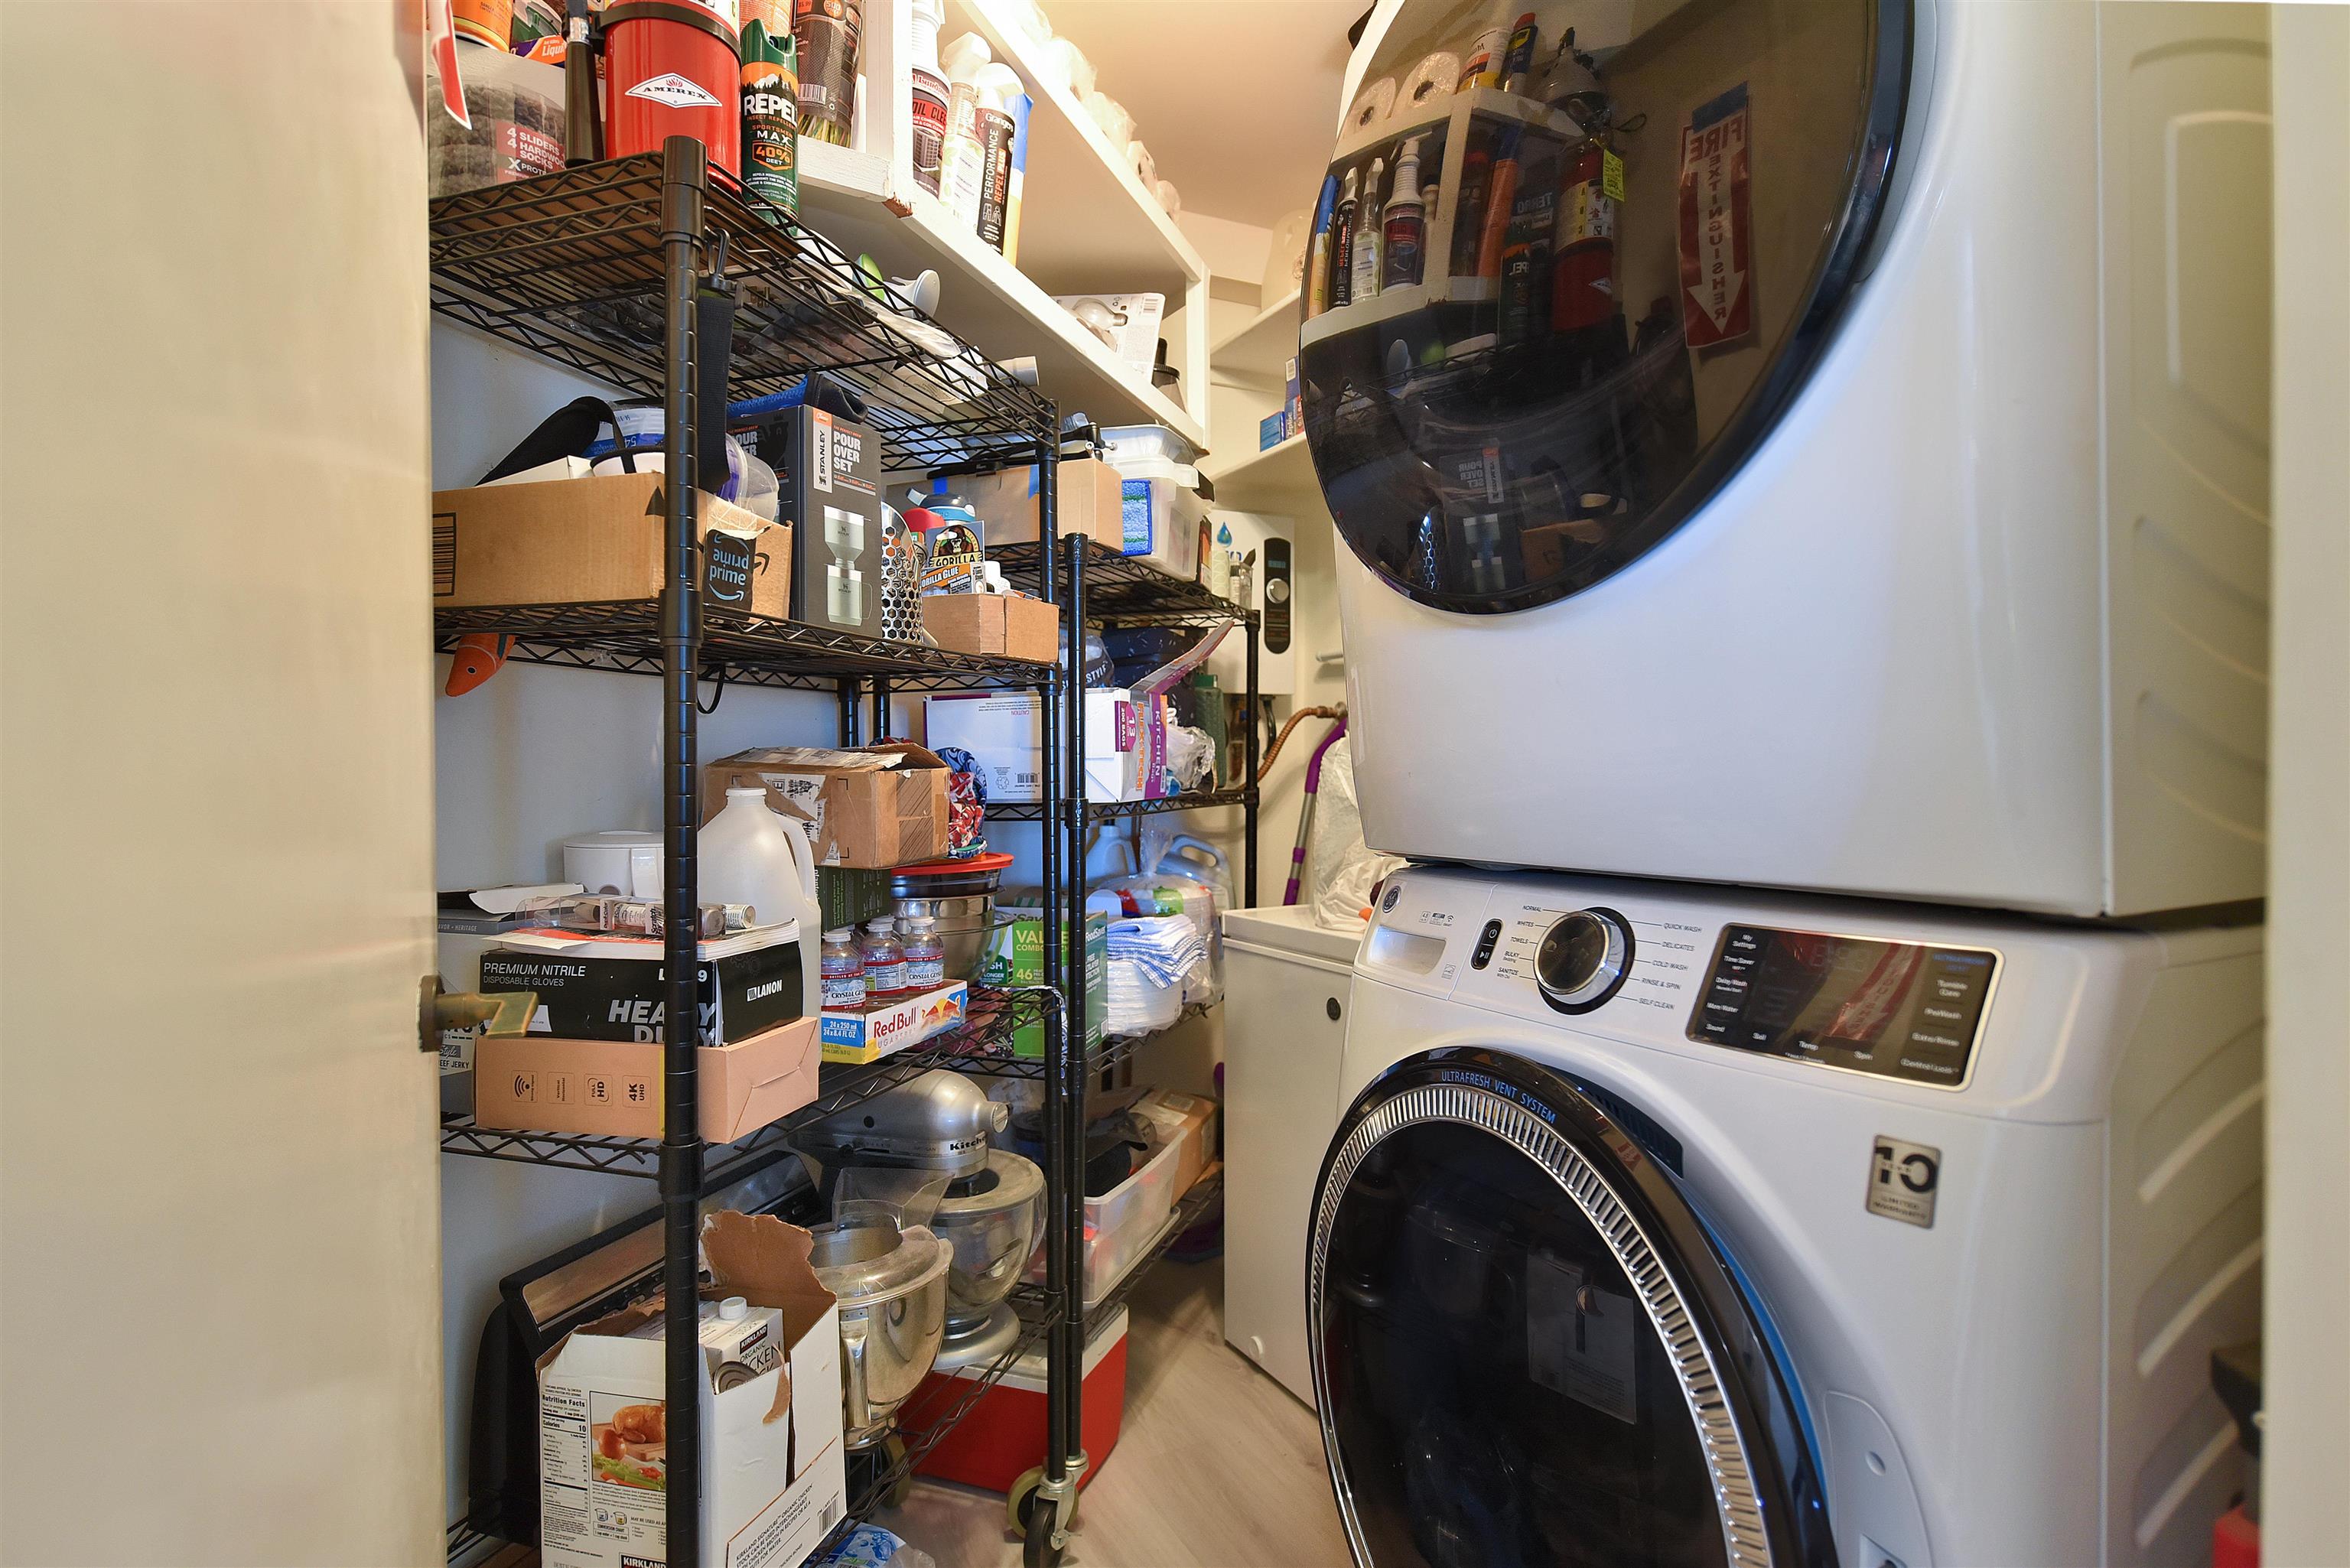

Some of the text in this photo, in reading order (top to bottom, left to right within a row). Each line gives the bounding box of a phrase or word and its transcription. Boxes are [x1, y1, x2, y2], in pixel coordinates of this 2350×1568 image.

[642, 86, 708, 100] AMEREX
[744, 93, 797, 127] REPEL
[913, 101, 926, 115] OIL
[752, 124, 793, 139] SPORTSMEN
[757, 130, 794, 149] MAX
[507, 128, 559, 156] 4 SLIDERS
[507, 138, 566, 170] 4 HARDWOO
[520, 151, 553, 169] SOCKS
[757, 146, 790, 163] 40%
[997, 150, 1007, 173] PLUS
[508, 157, 547, 176] X PROTE
[984, 129, 999, 200] PERFORMANCE
[994, 174, 1004, 203] REPEL
[732, 431, 757, 445] OUR
[833, 431, 861, 451] POUR
[742, 444, 757, 456] ER
[833, 444, 861, 464] OVER
[833, 457, 853, 473] SET
[713, 548, 749, 570] prime
[936, 555, 975, 567] GORILLA
[710, 564, 747, 586] prime
[921, 573, 942, 587] ORILLA
[1128, 717, 1136, 737] 13
[1086, 926, 1106, 943] FoodSaver
[1683, 925, 1702, 933] WASH
[1662, 941, 1695, 952] DELICATES
[1732, 941, 1757, 950] Settings
[483, 962, 587, 977] PREMIUM NITRILE
[1016, 968, 1033, 980] 46
[1498, 967, 1519, 975] SANITIZE
[1669, 962, 1688, 971] WASH
[483, 975, 565, 987] DISPOSABLE GLOVES
[1641, 978, 1659, 986] RINSE
[1715, 977, 1748, 987] Delay Wash
[1936, 979, 1968, 991] Tumble
[757, 980, 783, 999] LANON
[1938, 987, 1961, 998] Care
[608, 1000, 717, 1026] HEAY
[1653, 1000, 1675, 1010] CLEAN
[1722, 1005, 1739, 1013] Water
[874, 1007, 916, 1038] Red Bull
[1705, 1023, 1726, 1033] Sound
[634, 1025, 717, 1047] DUY
[1752, 1032, 1767, 1041] Soil
[1798, 1040, 1819, 1051] Temp
[1854, 1050, 1873, 1061] Spin
[440, 1059, 470, 1069] EEF JERKY
[1900, 1058, 1932, 1070] Control
[597, 1081, 605, 1098] HD
[628, 1083, 638, 1101] 4K
[1441, 1071, 1557, 1124] ULTRAFRESH VENT SYSTEM
[1875, 1146, 1938, 1193] 10
[740, 1326, 767, 1348] KIRKLAND
[740, 1340, 766, 1363] ORGANIC
[542, 1394, 585, 1407] Nutrition Facts
[736, 1538, 757, 1561] KIRKLAND
[781, 1498, 799, 1518] ORGANIC
[798, 1482, 813, 1501] CHICKEN
[736, 1553, 752, 1568] STOCK
[750, 1544, 761, 1556] CAN
[765, 1529, 776, 1540] USED
[775, 1497, 808, 1531] INTERCHANGEABLY
[748, 1546, 767, 1564] CHICKEN
[766, 1533, 780, 1549] BROTH
[783, 1514, 798, 1531] RECIPES
[760, 1537, 782, 1560] FOR WATER
[623, 1557, 666, 1568] KIRKLAND
